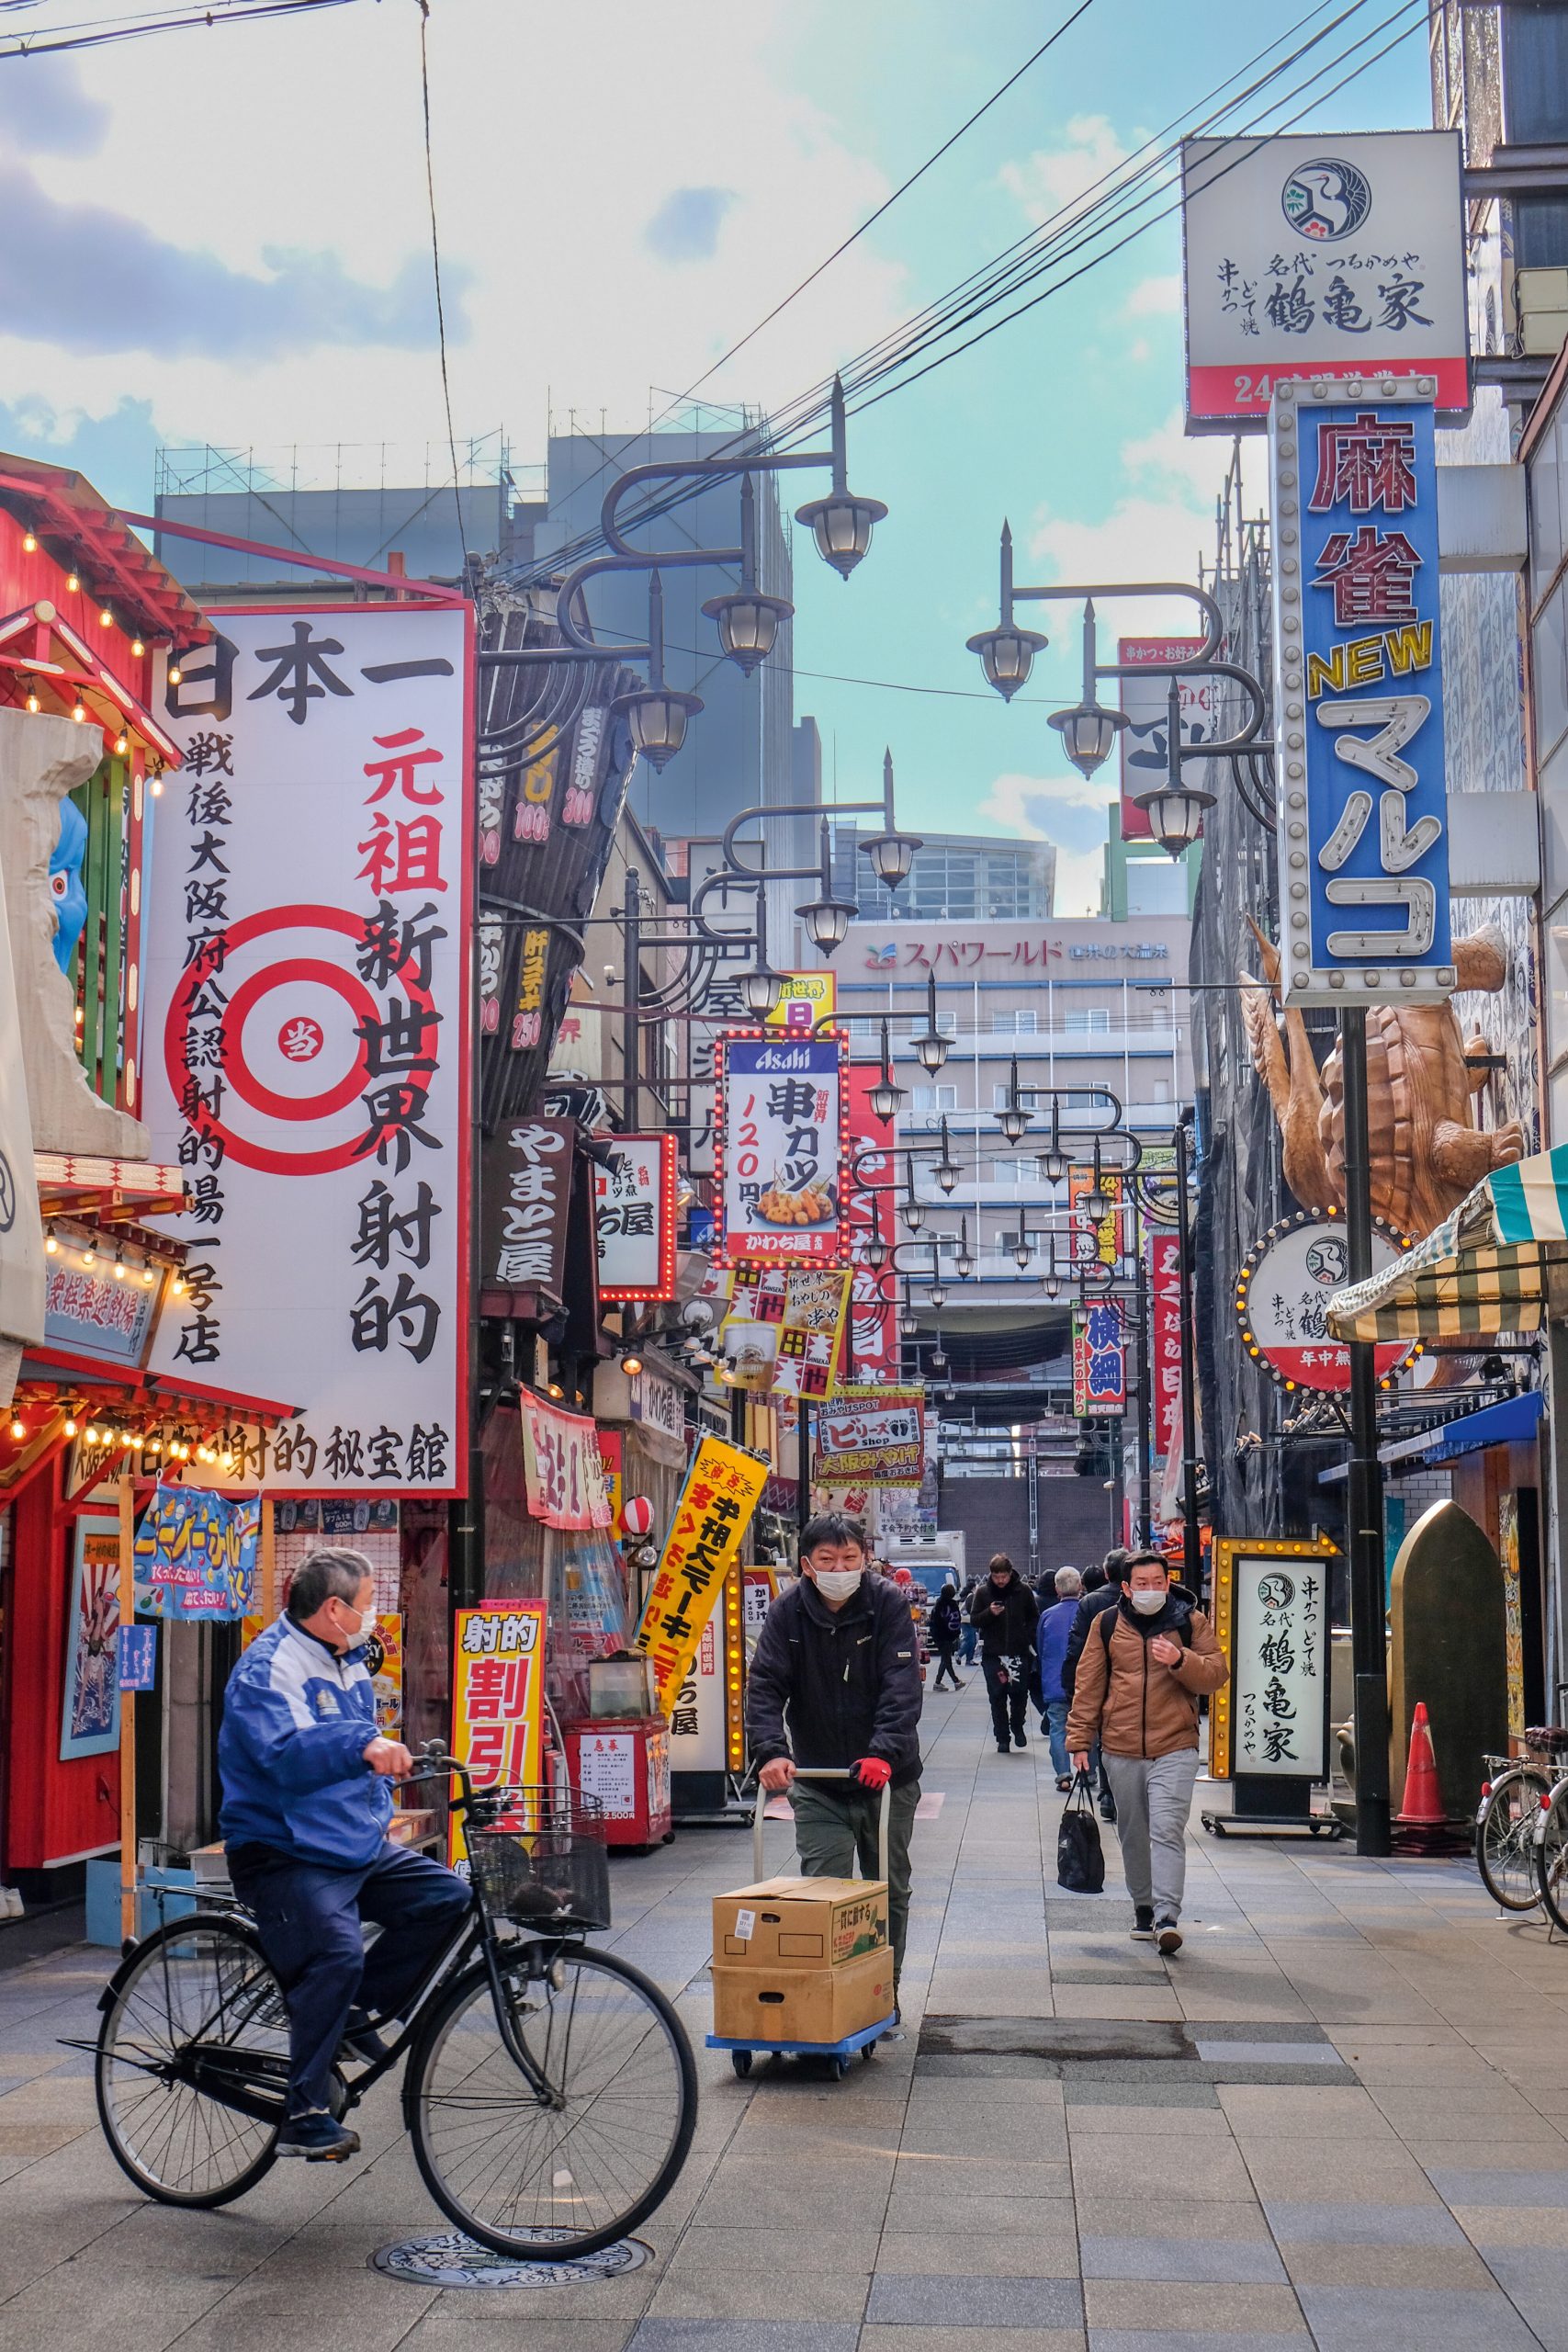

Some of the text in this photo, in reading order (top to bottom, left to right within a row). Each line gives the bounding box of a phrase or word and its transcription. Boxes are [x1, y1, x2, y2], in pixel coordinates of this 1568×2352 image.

[1264, 252, 1420, 276] 名代 つるかめや
[1217, 258, 1239, 314] 串かつ
[1264, 273, 1435, 334] 鶴亀家
[1240, 278, 1261, 335] どて焼
[1308, 413, 1425, 627] 麻雀
[164, 621, 455, 725] 日本一
[1307, 618, 1434, 701] NEW
[1315, 695, 1442, 957] マルコ
[518, 929, 548, 1011] 肝ステーキ
[904, 939, 1169, 967] スパワールド 世界の大温泉
[286, 1021, 320, 1063] 当
[512, 1012, 541, 1047] 250
[755, 1046, 810, 1070] Asahi
[813, 1088, 829, 1125] 新世界
[765, 1077, 819, 1193] 串カツ
[496, 1124, 565, 1283] やまと屋
[611, 1174, 623, 1198] カツ
[745, 1234, 811, 1250] かわち屋
[788, 1272, 825, 1289] 新世界
[792, 1290, 830, 1307] おやじの
[1298, 1290, 1330, 1306] 名代
[49, 1268, 138, 1334] 衆娯楽遊戯場
[1272, 1293, 1284, 1326] 串かつ
[1285, 1306, 1297, 1340] どて焼
[1074, 1338, 1085, 1414] 日本一の串かつ
[820, 1401, 880, 1417] おみやげSPOT
[829, 1417, 890, 1449] ビリーズ
[862, 1437, 890, 1447] Shop
[141, 1422, 450, 1483] 日本射的秘宝館
[818, 1443, 920, 1476] 大阪みやげ
[874, 1465, 919, 1479] 毎度おおきに
[660, 1494, 740, 1640] 牛肝ステーキ
[754, 1589, 767, 1620] かす汁
[1260, 1611, 1294, 1627] 名代
[462, 1614, 539, 1654] 射的
[1300, 1576, 1319, 1677] 串かつ どて焼
[1258, 1629, 1300, 1763] 鶴亀家
[1243, 1693, 1256, 1756] つるかめや
[594, 1738, 619, 1752] 急募
